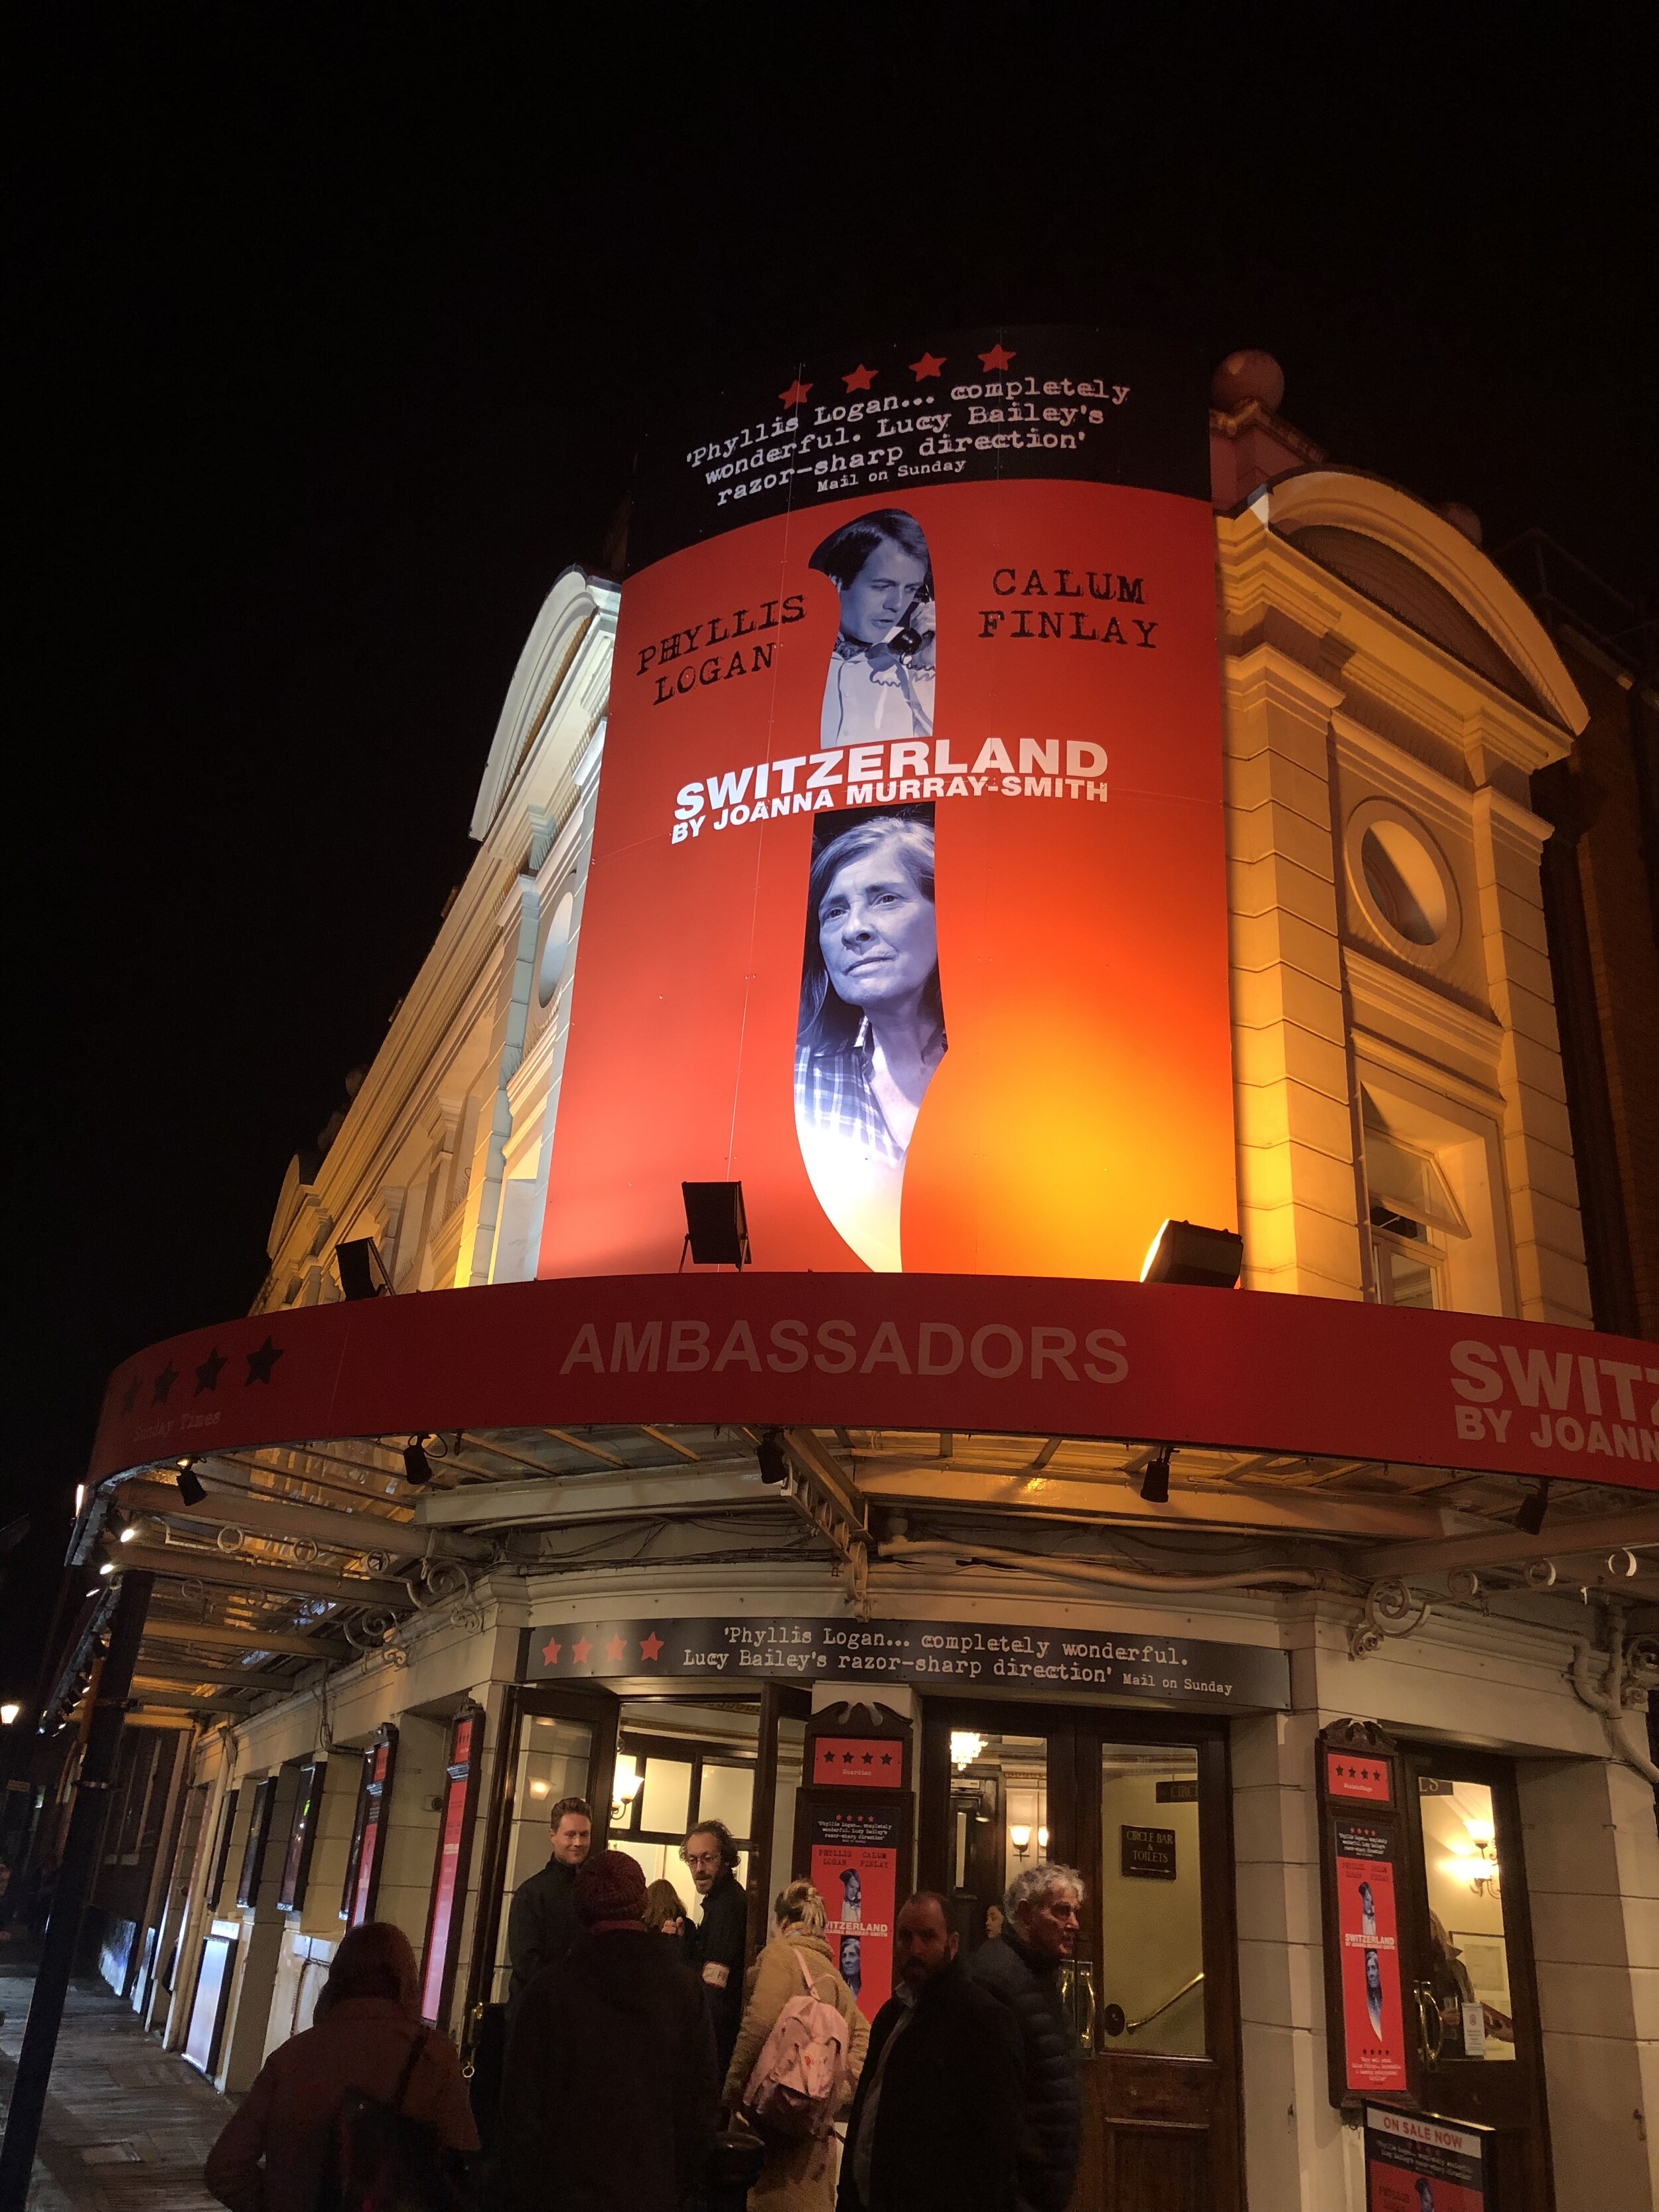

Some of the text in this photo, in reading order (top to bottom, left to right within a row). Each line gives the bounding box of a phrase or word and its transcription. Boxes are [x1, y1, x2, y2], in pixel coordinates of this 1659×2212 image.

[686, 376, 1130, 467] 'Phyllis Logan... completely
[705, 402, 1104, 484] wonderful. Lucy Bailey's
[717, 427, 1086, 506] razor-sharp direction'
[817, 458, 966, 492] Mail on Sunday
[992, 568, 1145, 605] CALUM
[635, 594, 806, 676] PHYLLIS
[978, 611, 1159, 649] FINLAY
[653, 642, 776, 706] LOGAN
[673, 737, 1109, 821] SWITZERLAND
[672, 776, 1108, 844] BY JOANNA MURRAY-SMITH
[558, 1319, 1129, 1384] AMBASSADORS
[1455, 1405, 1512, 1443] BY
[724, 1626, 1189, 1666] 'Phyllis Logan... completely wonderful.
[683, 1649, 1233, 1696] Lucy Bailey's razor-sharp direction' Mail on Sunday
[818, 1849, 852, 1858] PHYLLIS
[1126, 1830, 1173, 1844] CIRCLE BAR
[1132, 1850, 1168, 1864] TOILETS
[1344, 1933, 1394, 1945] SWITZERLAND
[1384, 2116, 1463, 2149] ON SALE NOW
